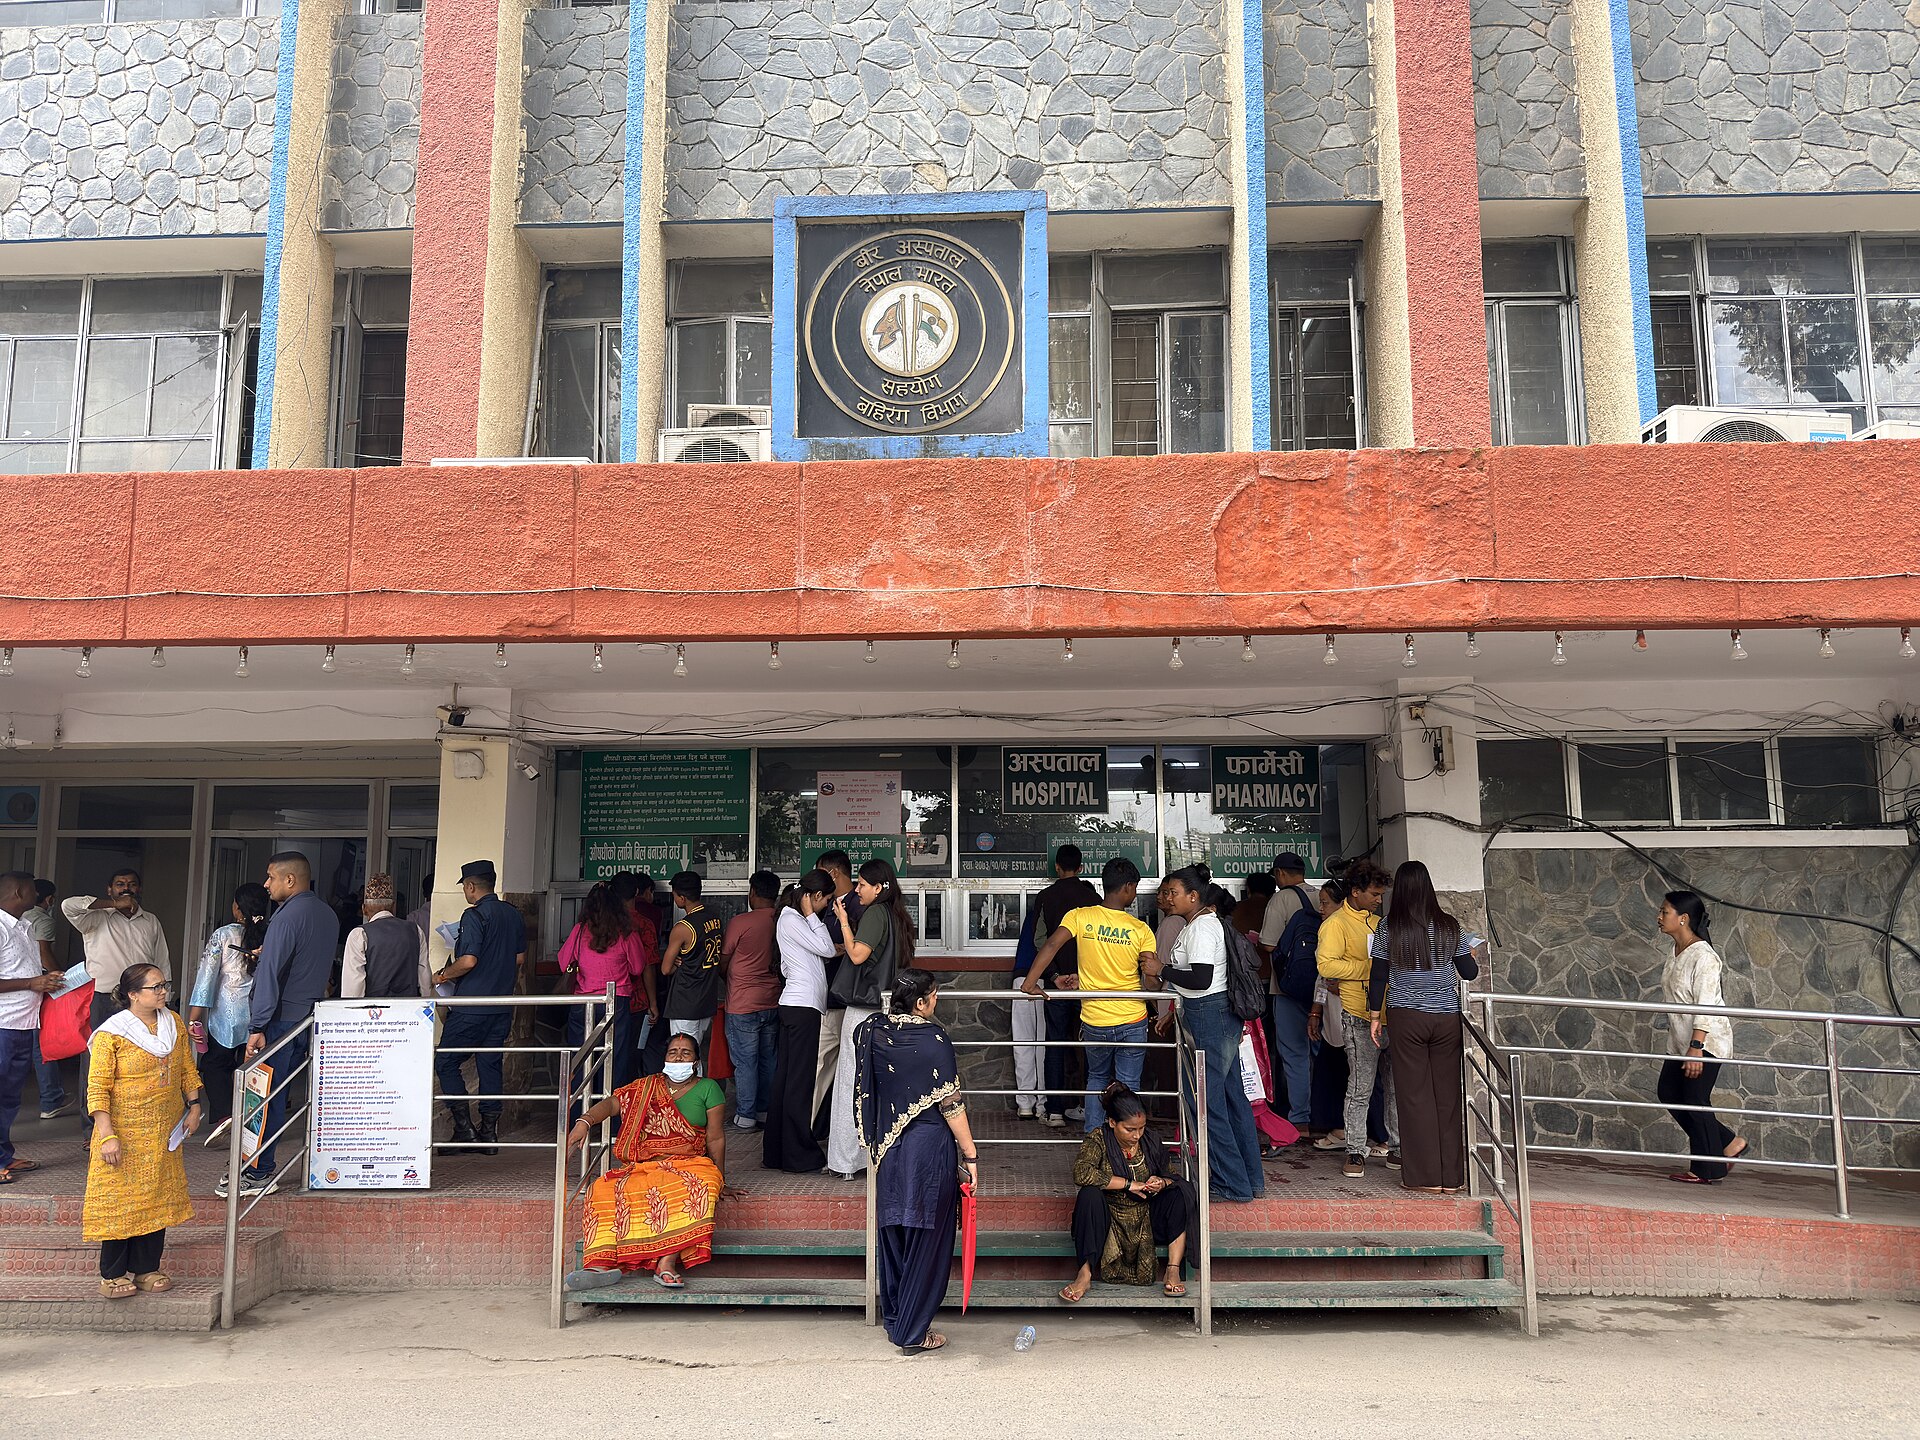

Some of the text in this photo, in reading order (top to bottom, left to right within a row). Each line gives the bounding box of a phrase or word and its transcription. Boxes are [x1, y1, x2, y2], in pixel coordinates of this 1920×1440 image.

[853, 239, 967, 270] बीर अस्पताल
[858, 266, 958, 294] नेपाल भारत
[881, 374, 943, 396] सहयोग
[856, 391, 968, 425] बहिरंग विभाग
[1008, 753, 1101, 773] अस्पताल
[1226, 750, 1304, 777] फार्मेसी
[1011, 781, 1099, 806] HOSPITAL
[1215, 783, 1318, 808] PHARMACY
[660, 864, 667, 876] 4
[1224, 861, 1273, 874] COUNTE
[1097, 924, 1132, 940] MAK
[1097, 935, 1131, 946] LUBRICANTS
